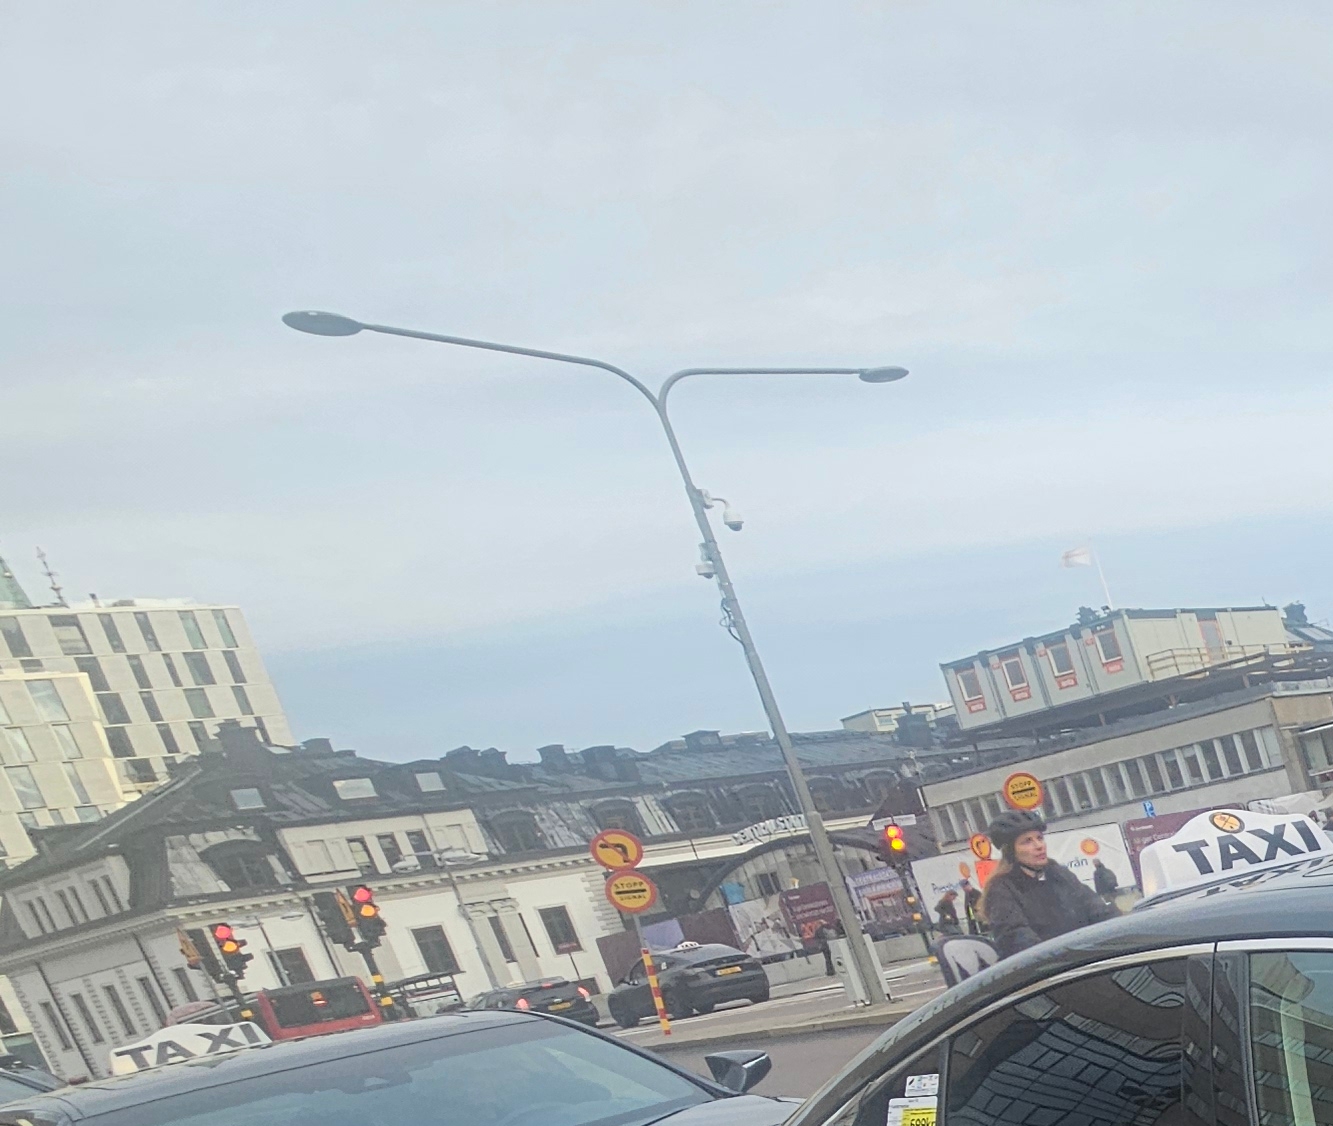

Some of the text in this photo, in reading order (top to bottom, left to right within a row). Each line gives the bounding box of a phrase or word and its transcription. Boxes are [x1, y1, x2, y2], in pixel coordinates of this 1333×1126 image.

[1171, 819, 1322, 876] TAXI
[614, 881, 644, 890] STOPP
[115, 1024, 261, 1069] TAXI
